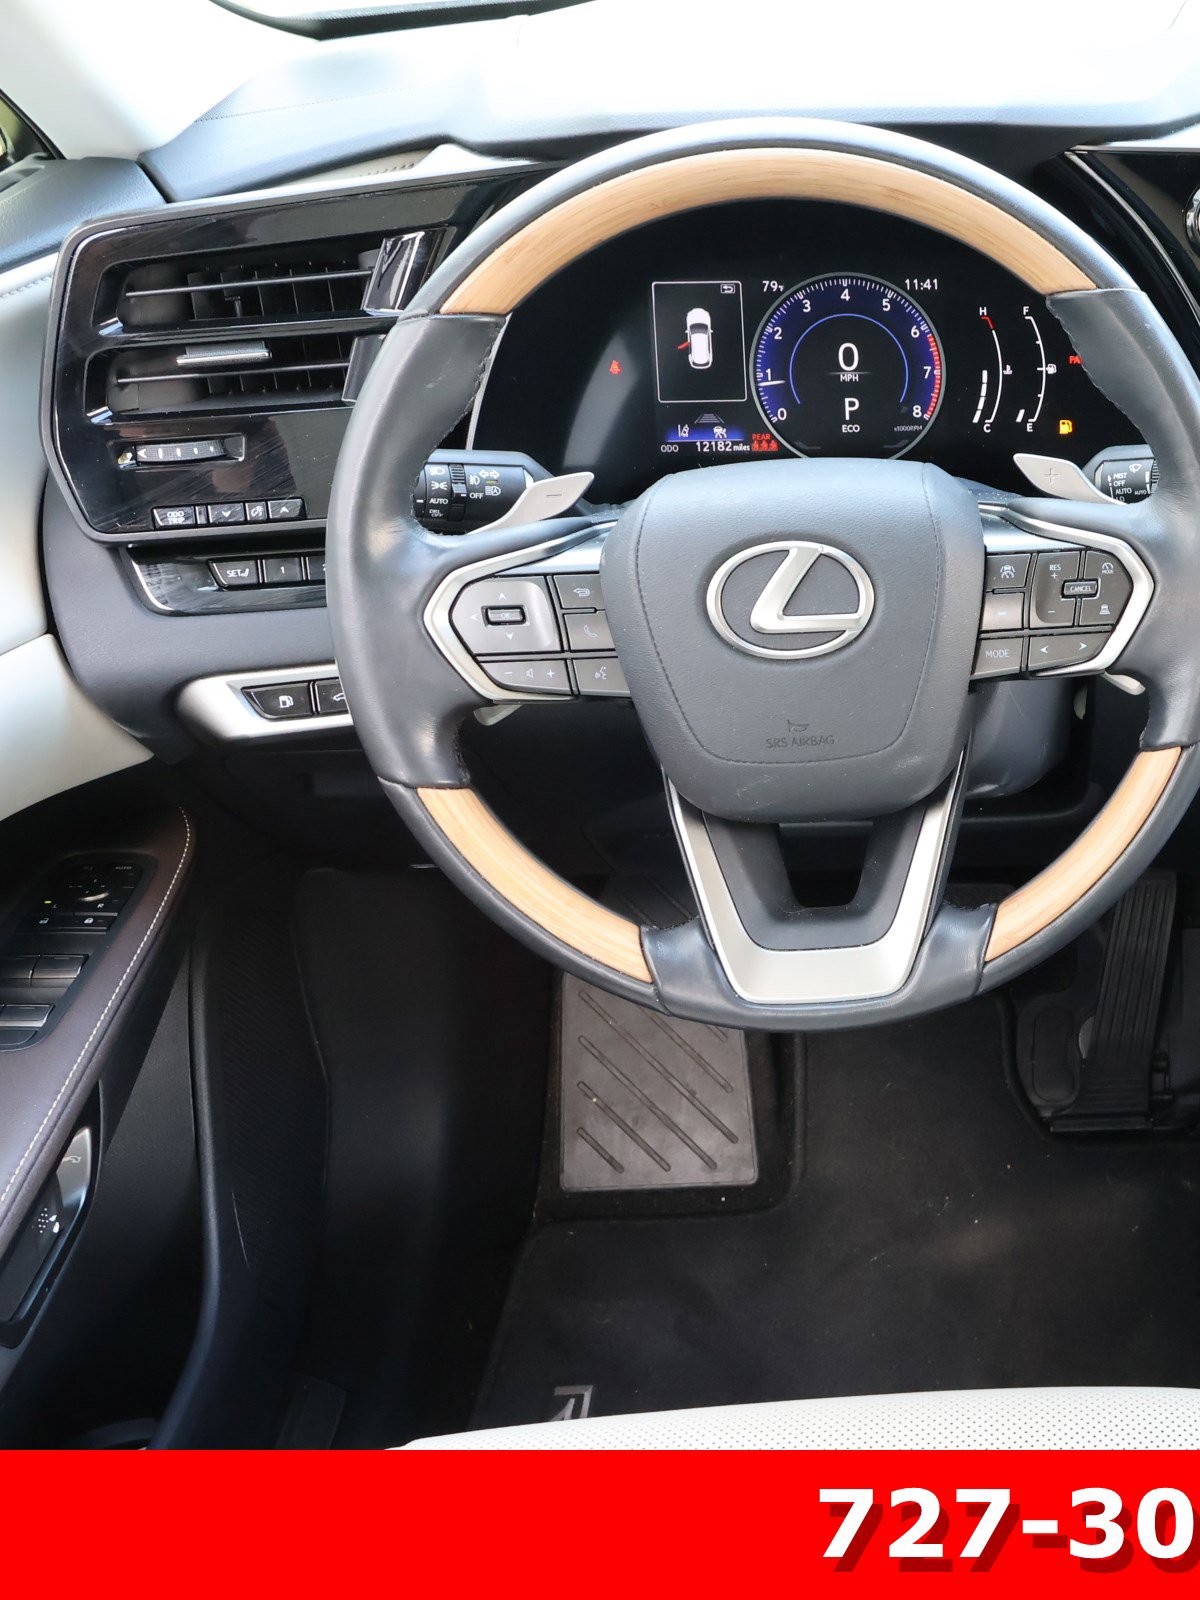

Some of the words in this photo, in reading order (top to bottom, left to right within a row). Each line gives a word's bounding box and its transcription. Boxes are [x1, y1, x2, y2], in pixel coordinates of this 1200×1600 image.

[905, 279, 939, 291] 11:41
[840, 289, 850, 301] 4
[802, 300, 811, 312] 3
[882, 299, 891, 311] 5
[979, 306, 987, 316] H
[1023, 306, 1030, 315] F
[774, 327, 783, 340] 2
[911, 325, 920, 338] 6
[838, 343, 859, 371] 0
[765, 369, 772, 381] 1
[840, 374, 859, 382] MPH
[923, 366, 931, 379] 7
[777, 408, 787, 421] 0
[844, 398, 860, 420] P
[912, 405, 922, 418] 8
[841, 424, 860, 433] ECO
[983, 423, 991, 433] C
[1027, 423, 1034, 432] E
[660, 444, 679, 453] ODO
[695, 440, 733, 452] 12182
[733, 443, 751, 452] miles
[469, 492, 484, 500] OFF
[167, 517, 185, 525] TRIP
[226, 569, 241, 578] SET
[280, 566, 285, 574] 1
[1050, 564, 1062, 572] RES
[1069, 585, 1093, 593] CANCEL
[985, 649, 1010, 658] MODE
[766, 737, 788, 748] SRS
[791, 735, 835, 747] AIRBAG
